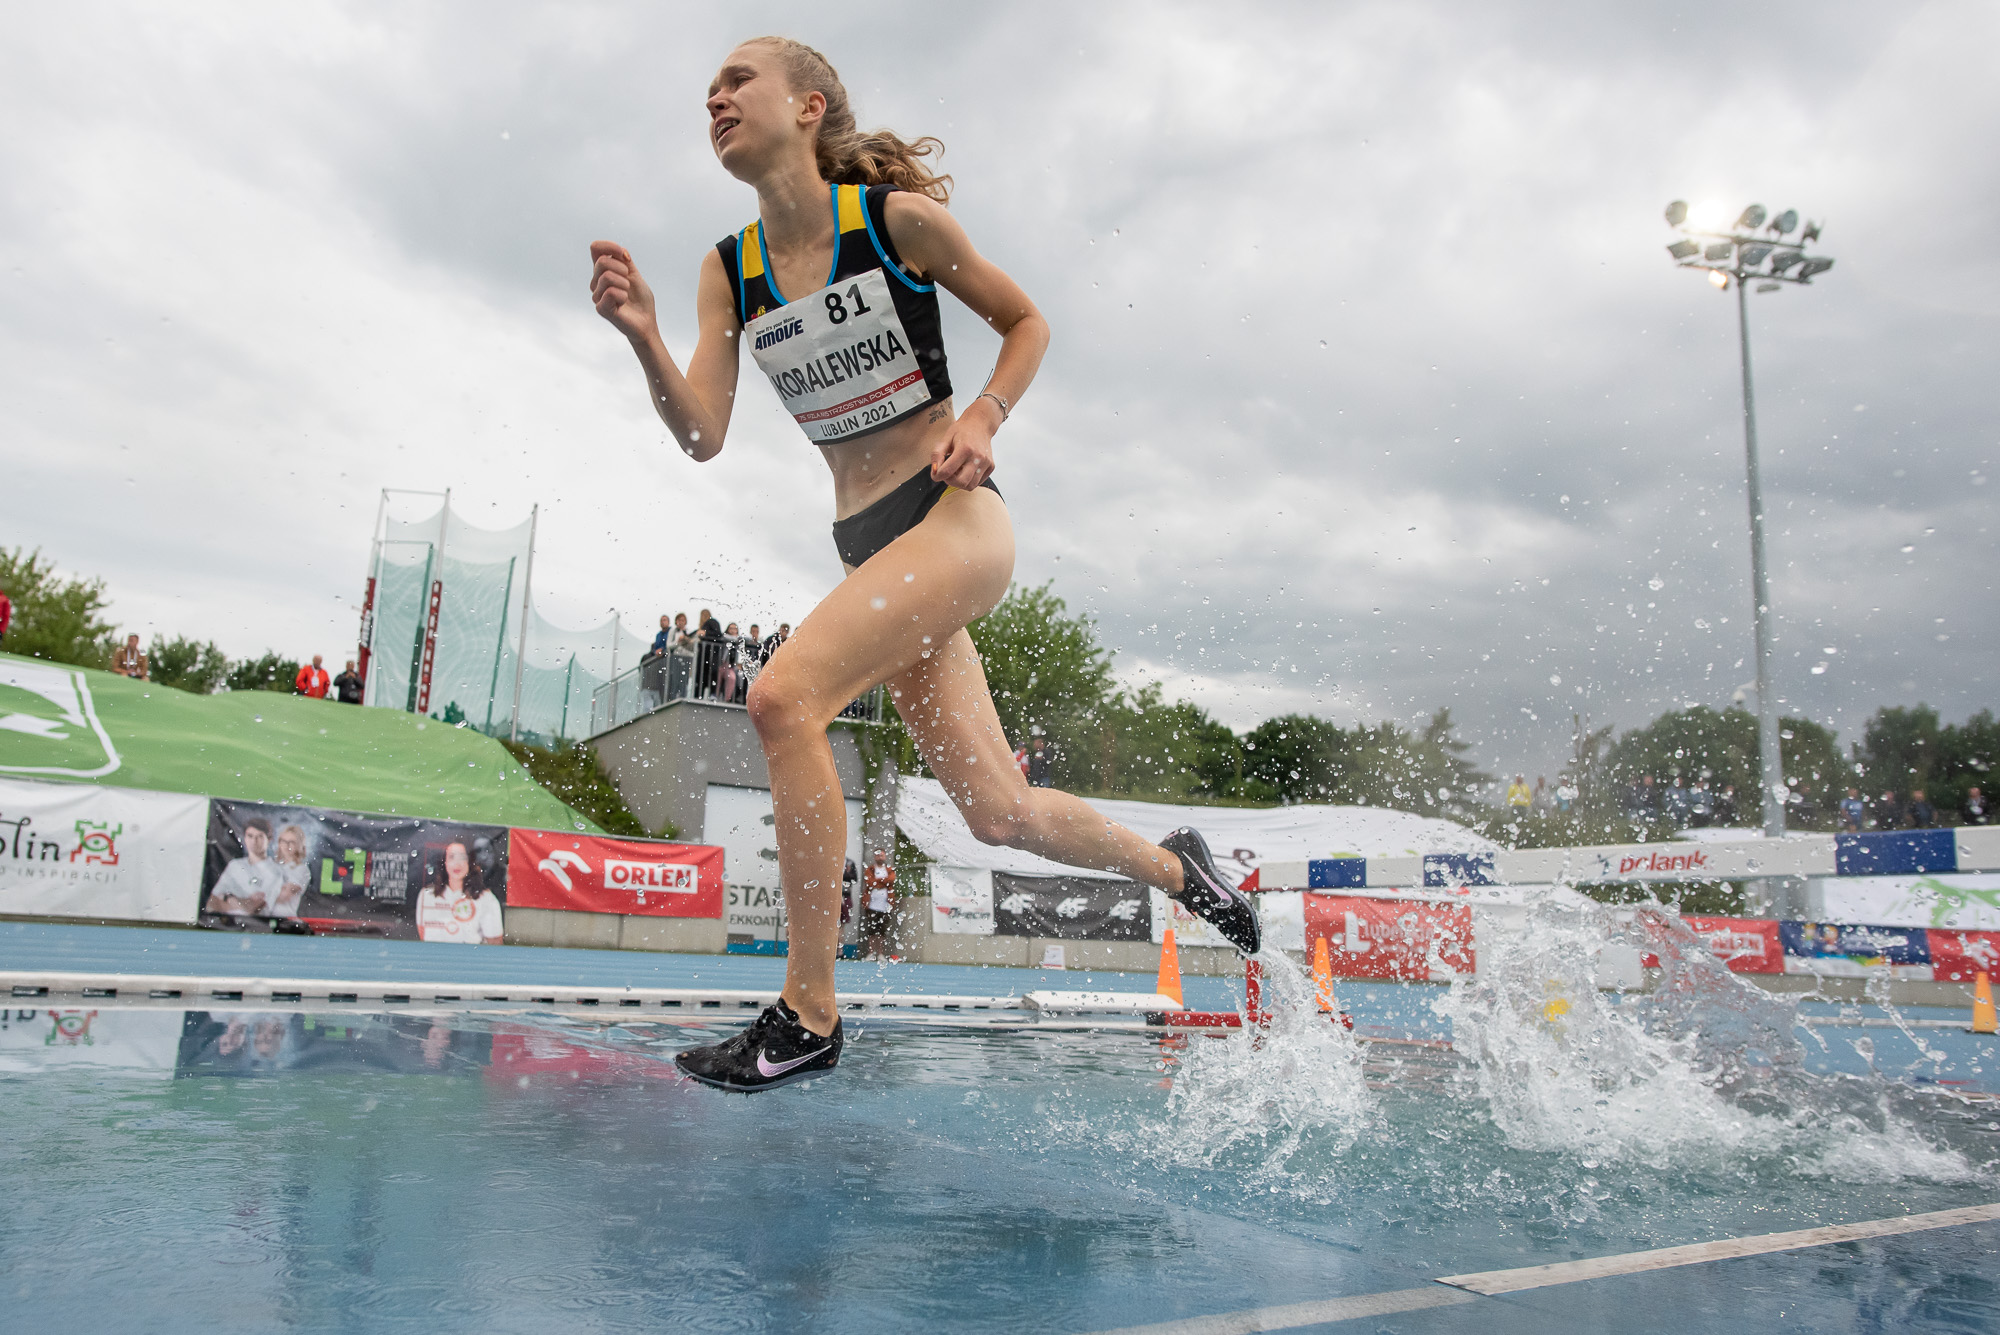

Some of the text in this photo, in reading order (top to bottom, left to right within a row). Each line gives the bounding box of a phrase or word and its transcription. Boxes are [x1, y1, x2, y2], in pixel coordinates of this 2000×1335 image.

[825, 283, 871, 325] 81
[771, 329, 907, 401] KORALEWSKA
[868, 383, 898, 401] POLSKI
[898, 374, 916, 387] U20
[820, 400, 897, 437] LUBLIN 2021
[610, 864, 692, 888] ORLEN
[1056, 897, 1089, 918] 4F
[1109, 899, 1142, 920] 4F
